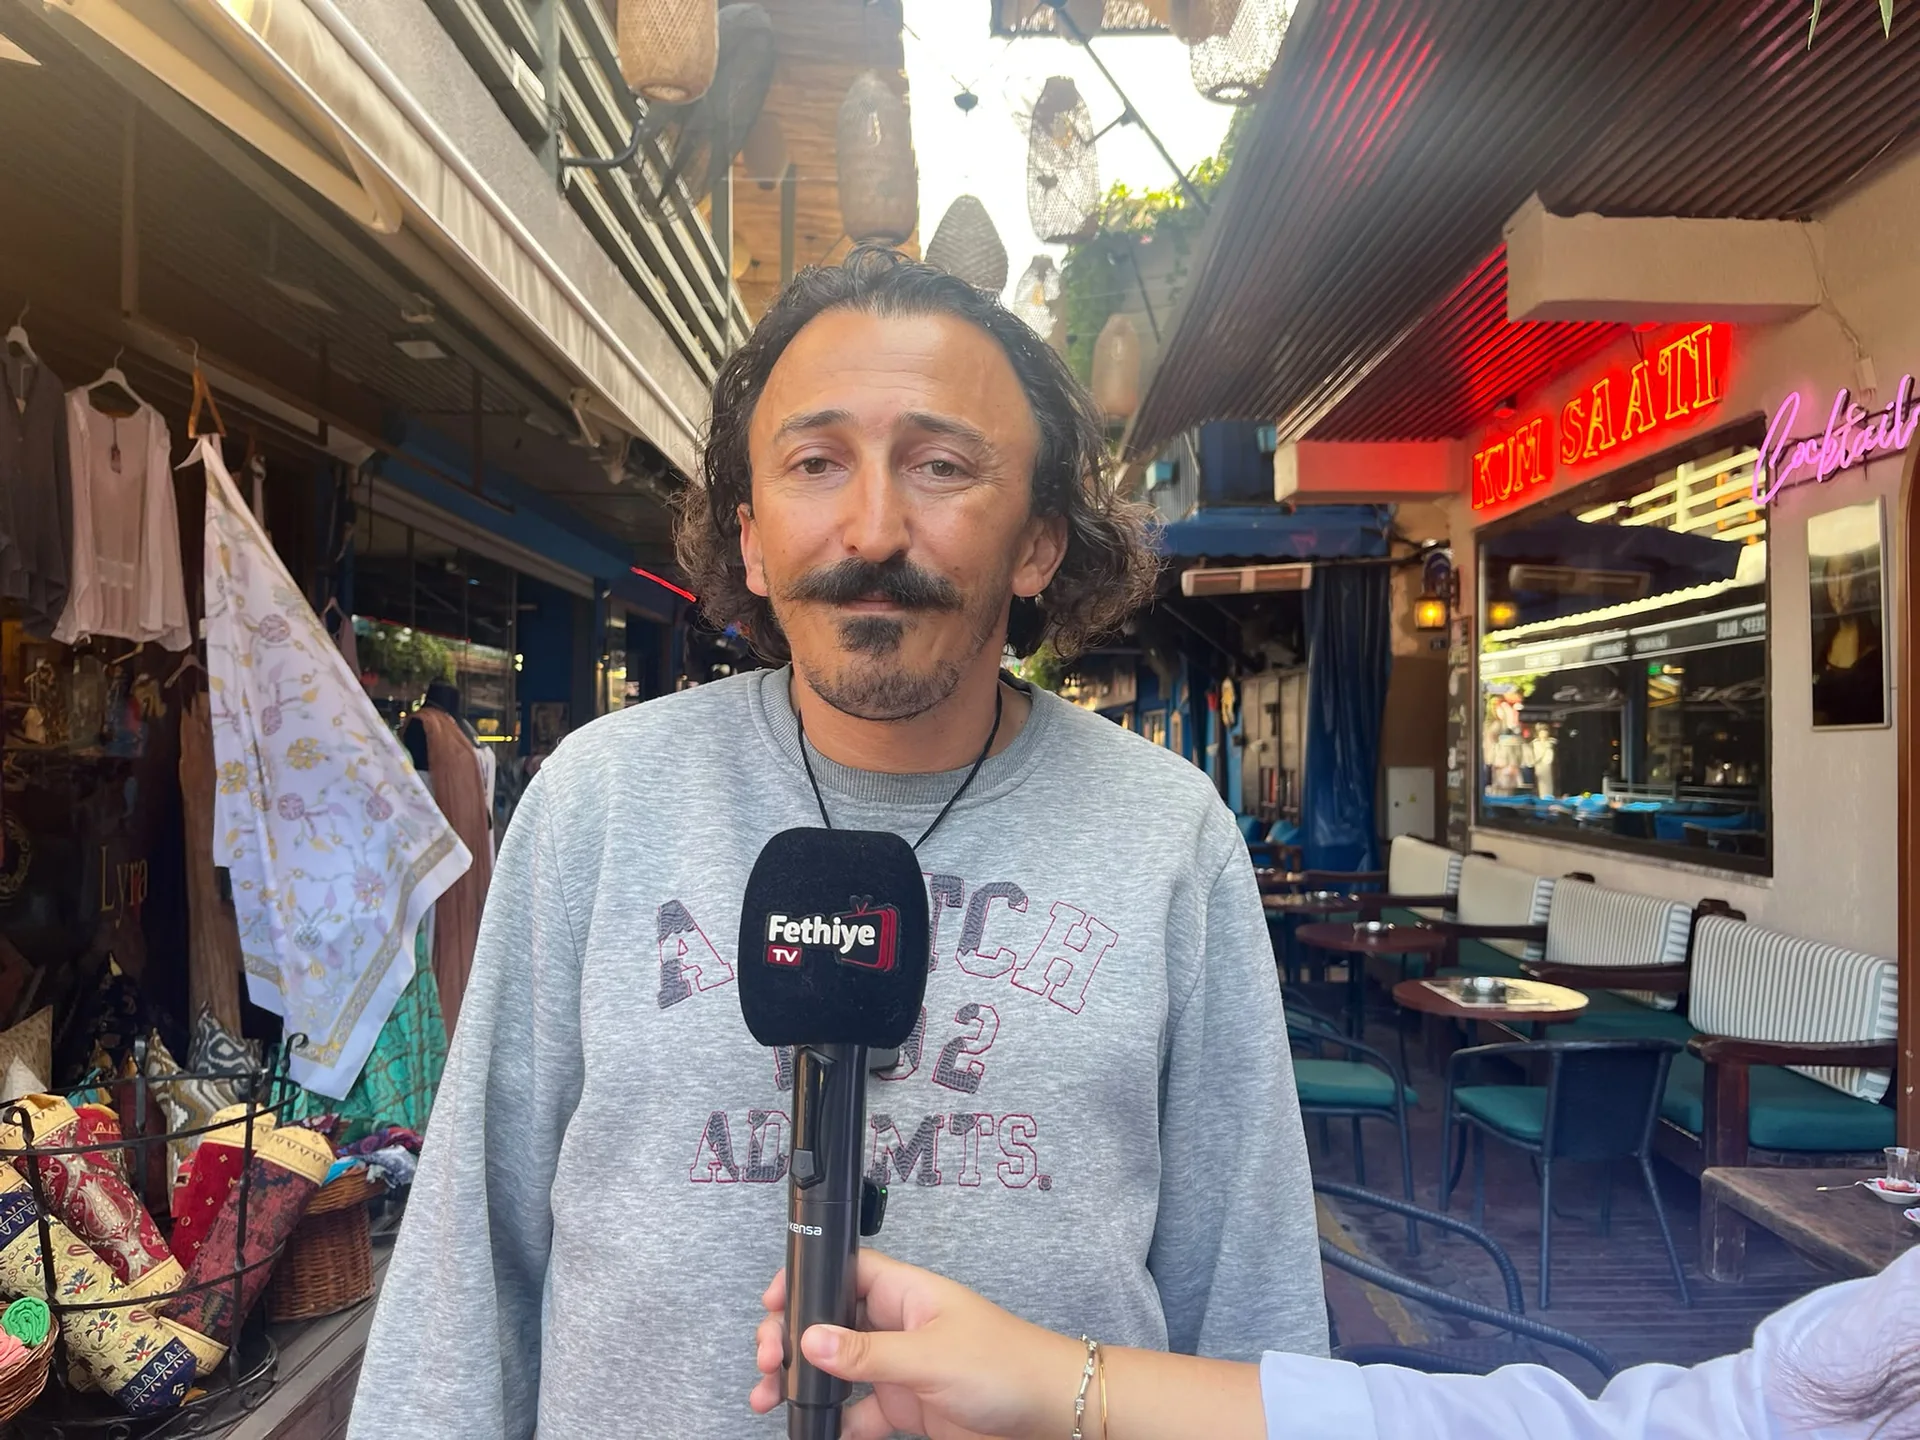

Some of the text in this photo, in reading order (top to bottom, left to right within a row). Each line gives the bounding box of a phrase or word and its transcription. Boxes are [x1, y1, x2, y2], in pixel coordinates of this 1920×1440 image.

[1472, 324, 1722, 510] KUM SAATI
[1752, 374, 1920, 505] Cocktail
[101, 845, 148, 929] Lyra
[768, 915, 876, 954] Fethiye
[772, 949, 798, 962] TV
